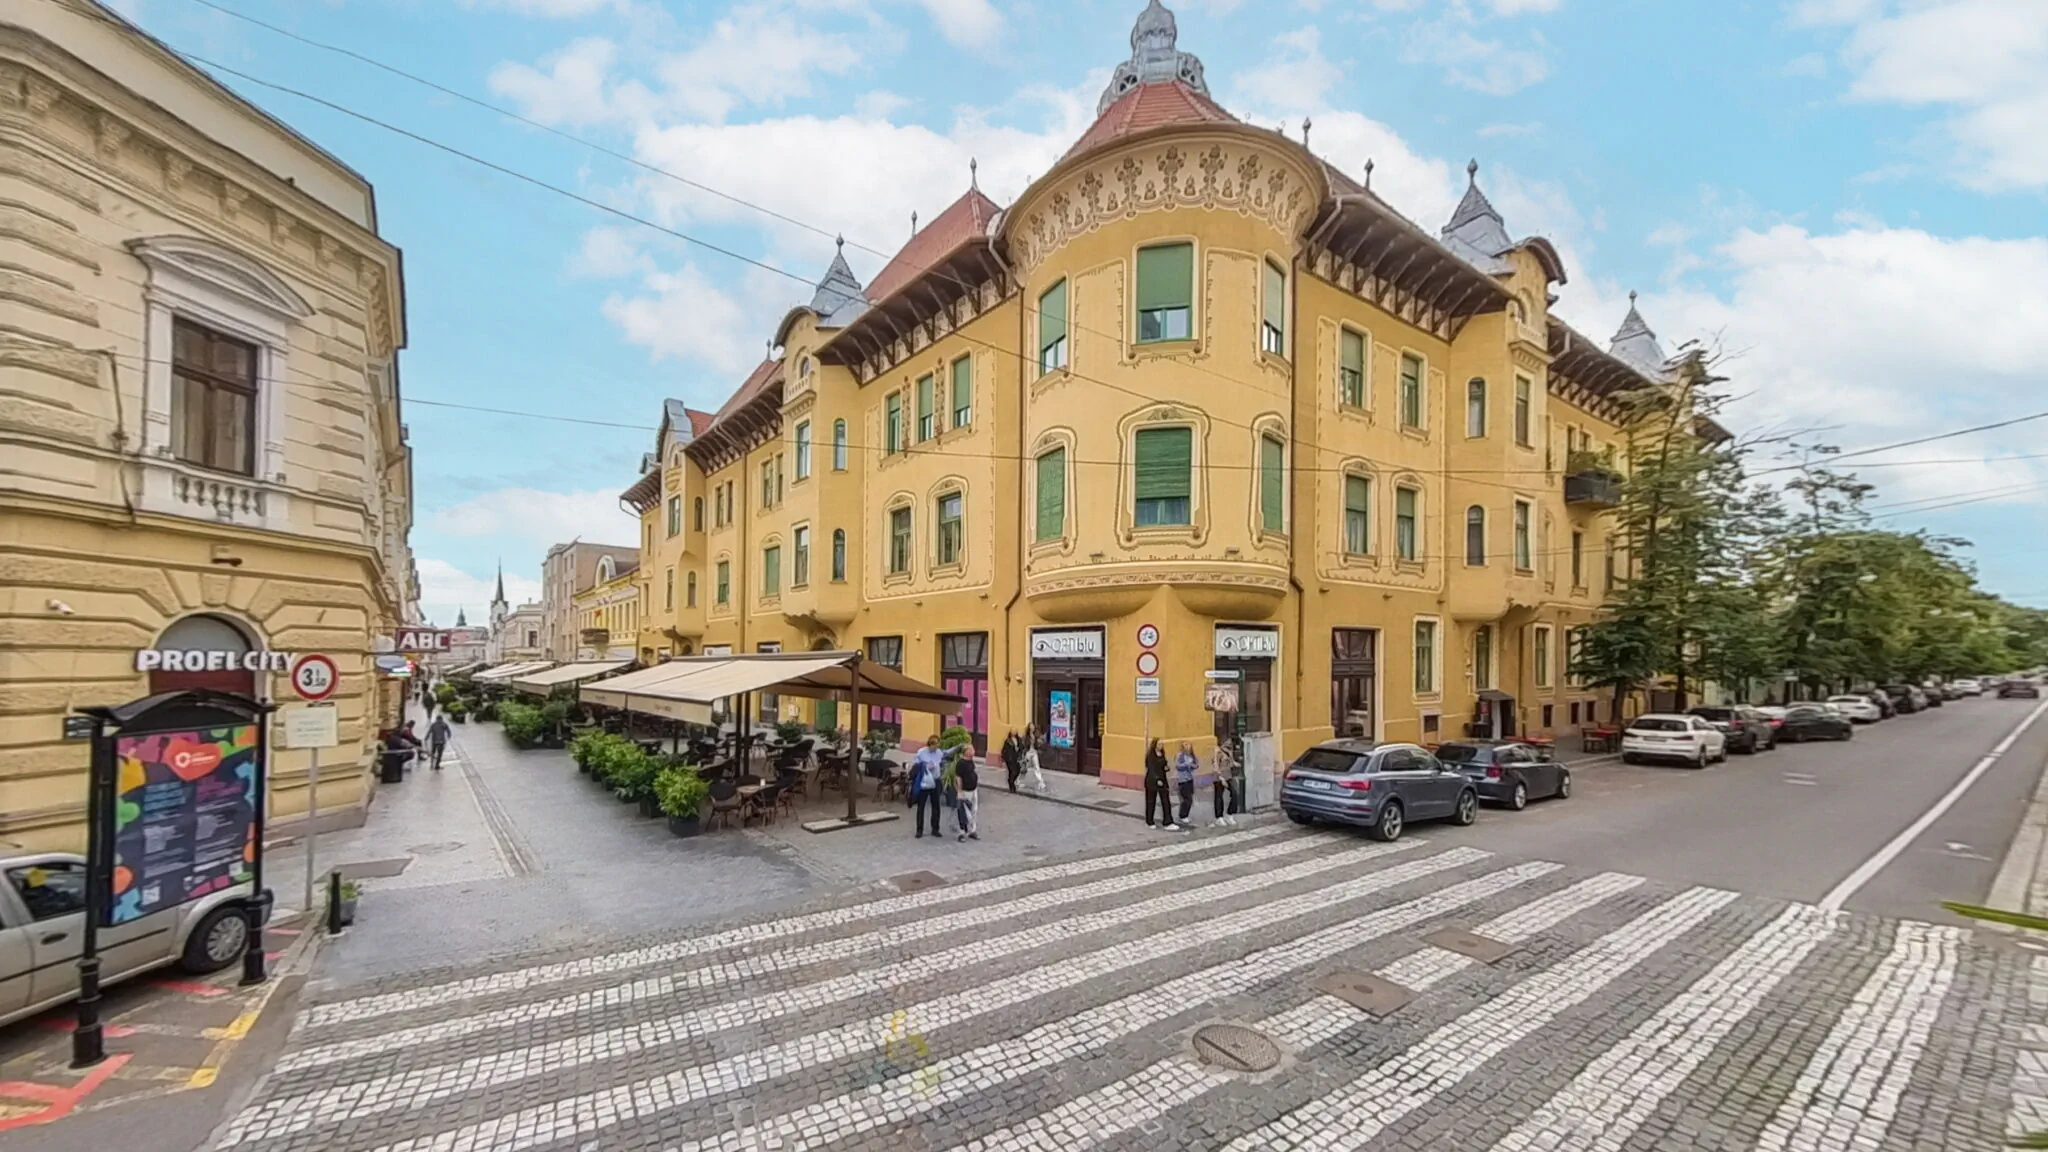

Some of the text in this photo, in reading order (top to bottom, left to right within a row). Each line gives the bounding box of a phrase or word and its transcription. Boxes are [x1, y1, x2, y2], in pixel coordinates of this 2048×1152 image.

[399, 632, 448, 649] ABC
[137, 650, 298, 671] PROFI CITY
